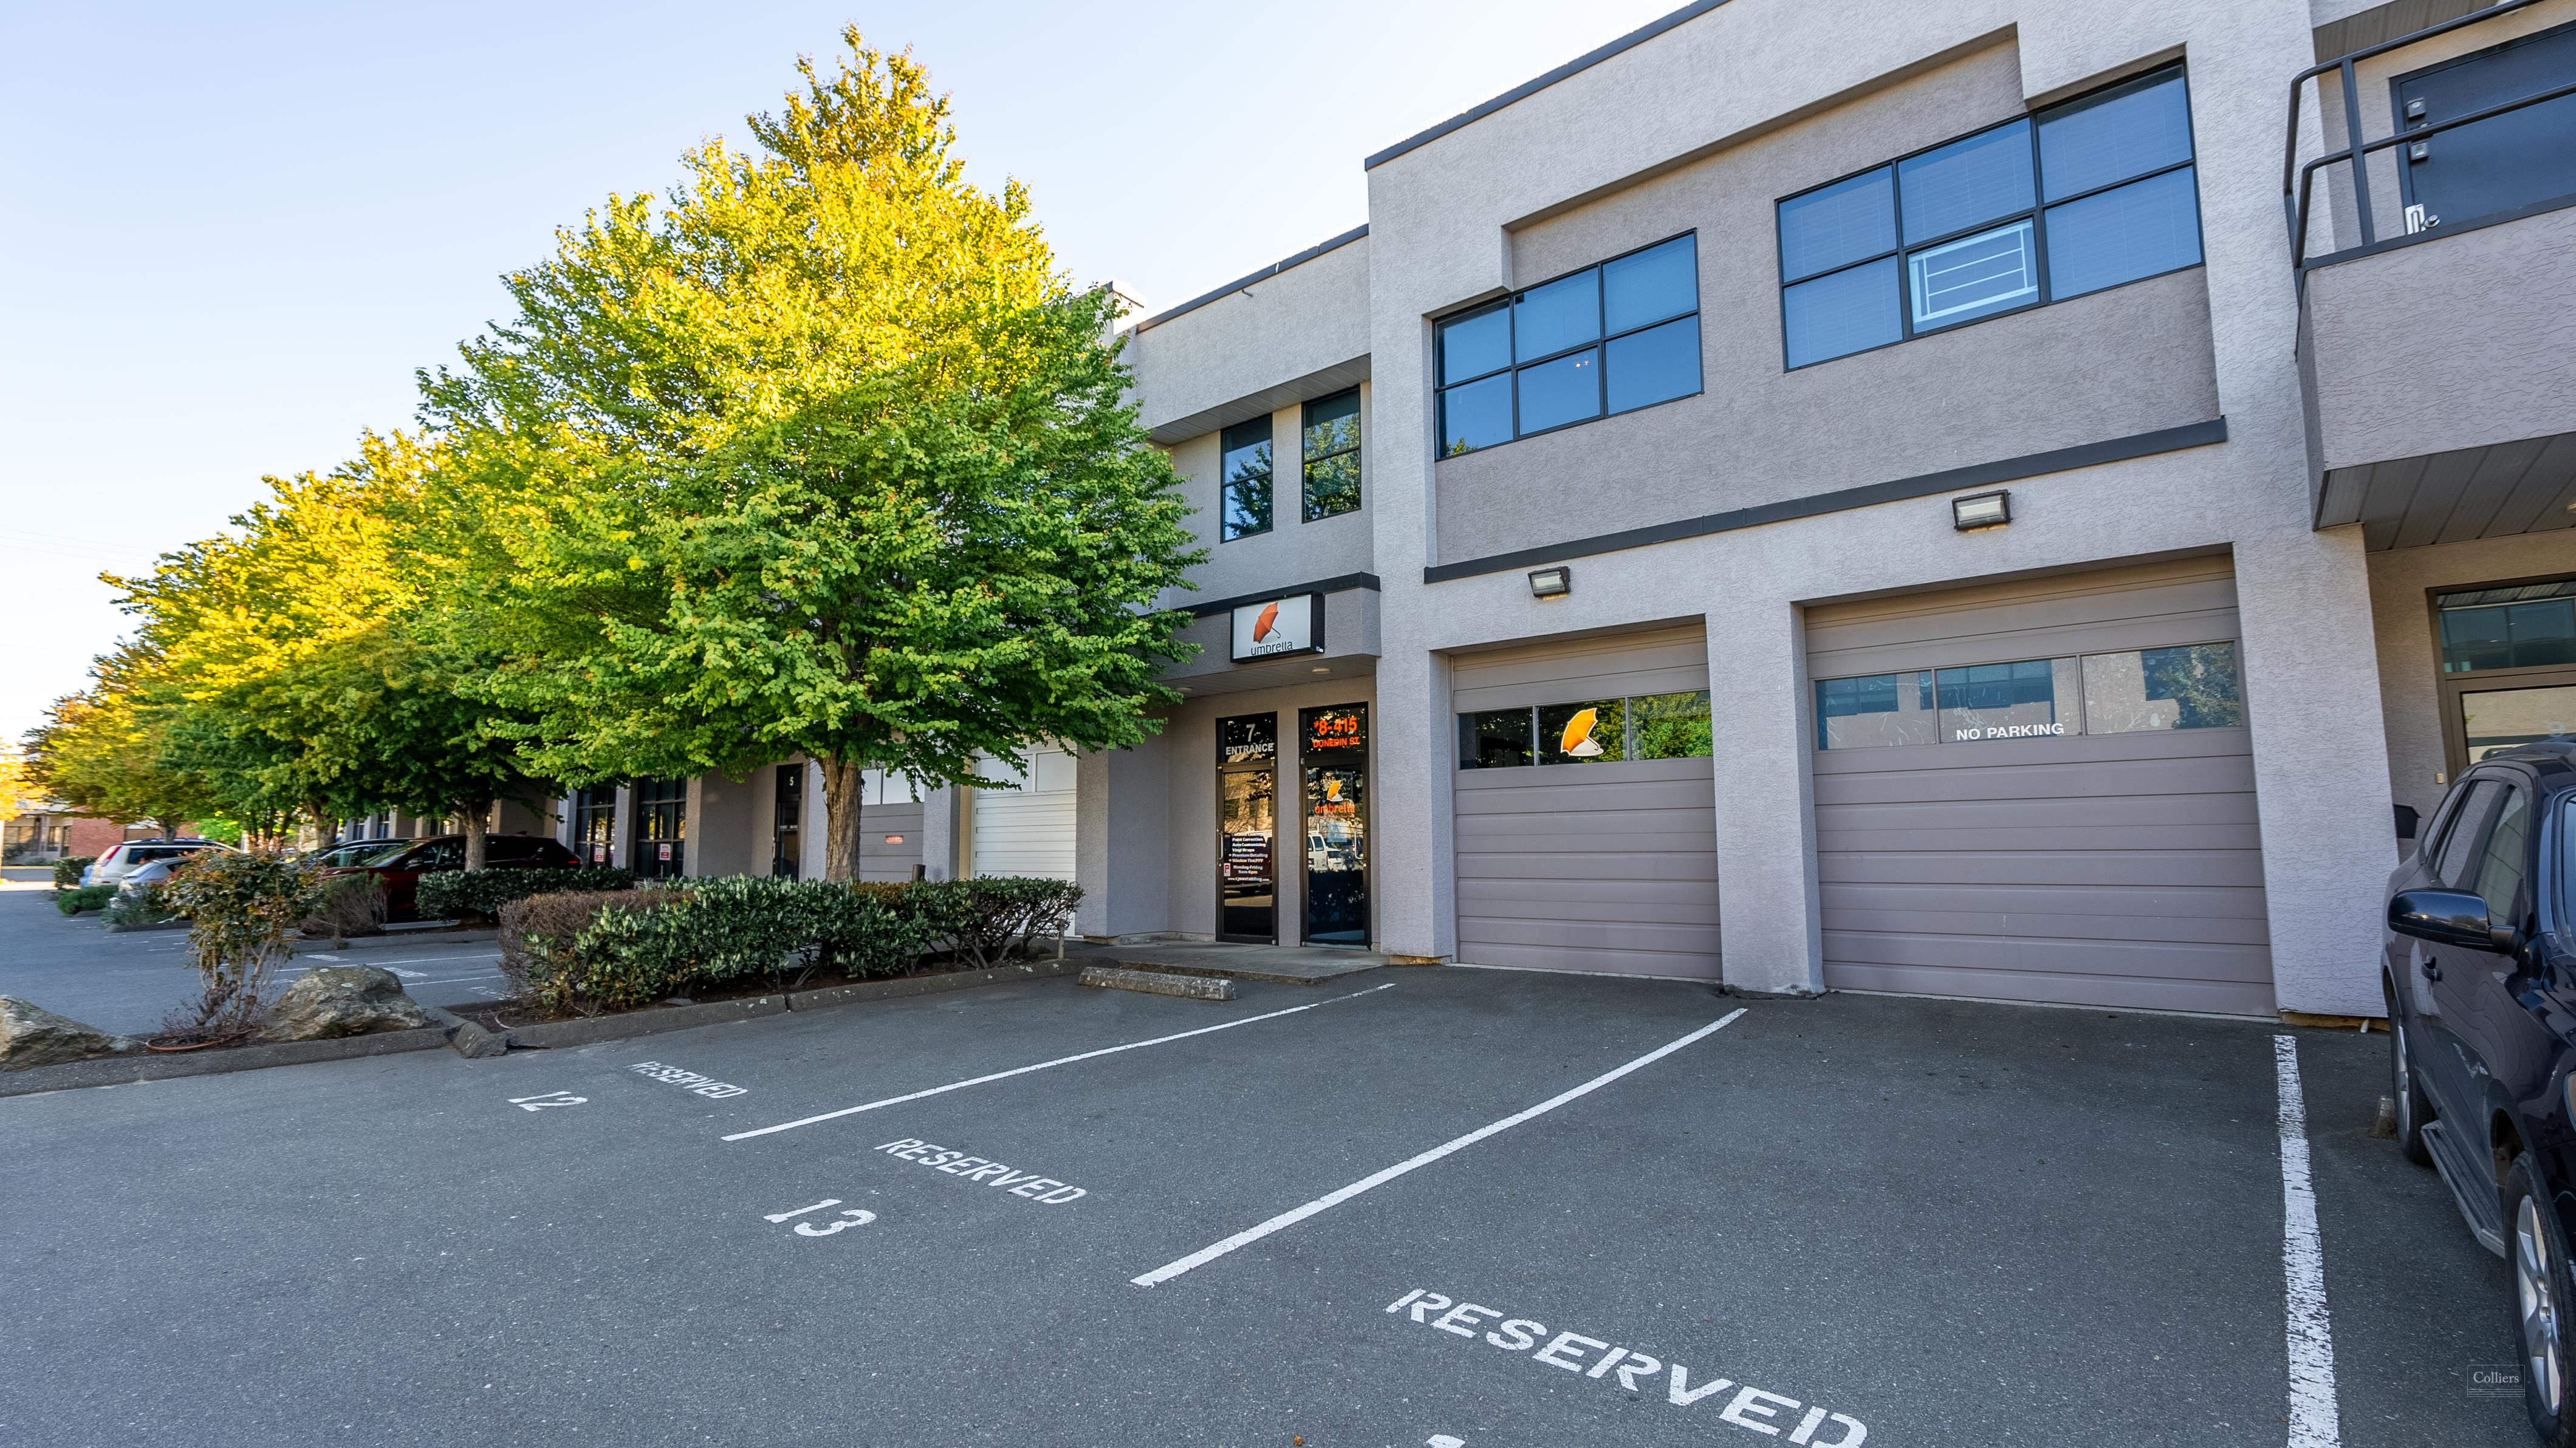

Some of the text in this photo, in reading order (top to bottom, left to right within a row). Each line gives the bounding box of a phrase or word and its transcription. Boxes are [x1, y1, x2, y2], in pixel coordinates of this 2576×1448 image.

[1251, 641, 1293, 655] umbrella
[1245, 723, 1256, 742] 7
[1314, 717, 1357, 736] #8-415
[1956, 723, 2064, 740] NO PARKING
[1225, 743, 1275, 755] ENTRANCE
[1312, 738, 1348, 748] DUNEDIN
[789, 776, 794, 786] 5
[1315, 801, 1355, 814] umbrella
[622, 1060, 748, 1099] RESERVED
[508, 1091, 588, 1112] 12
[874, 1138, 1088, 1204] RESERVED
[763, 1199, 877, 1237] 13
[1385, 1288, 1868, 1448] RESERVED
